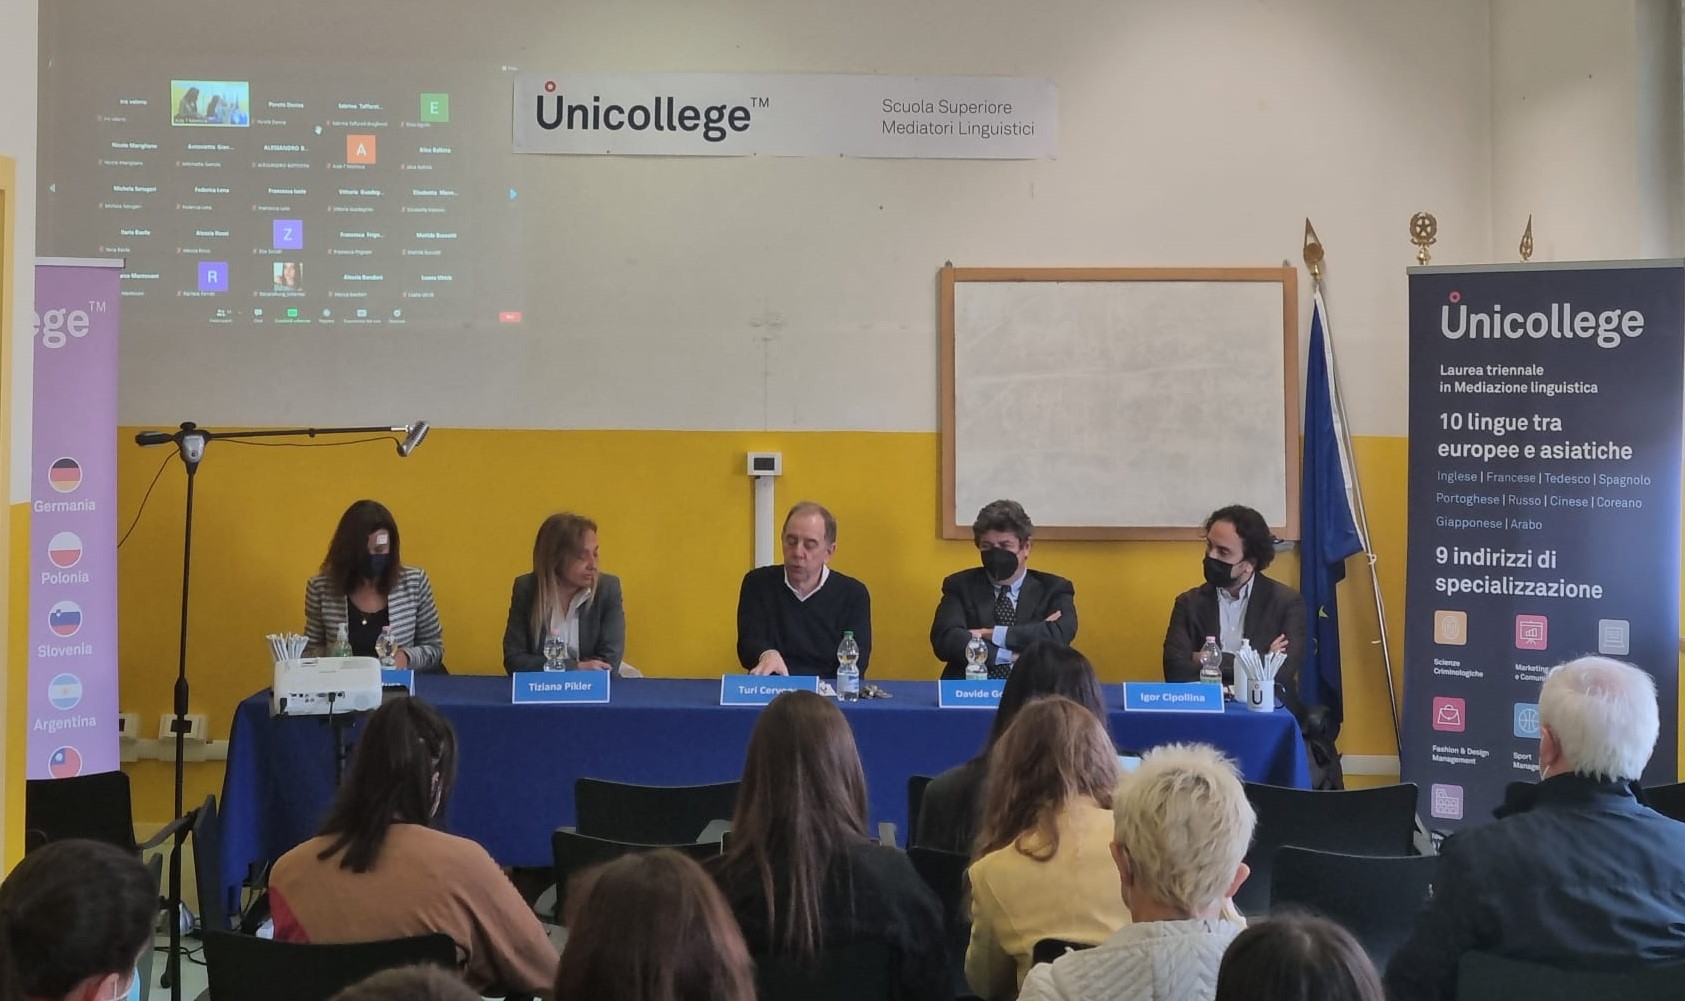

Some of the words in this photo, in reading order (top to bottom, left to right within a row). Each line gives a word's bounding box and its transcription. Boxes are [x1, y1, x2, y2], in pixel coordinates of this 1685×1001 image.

[430, 101, 439, 114] E
[882, 98, 934, 115] Scuola
[938, 99, 1012, 118] Superiore
[882, 121, 954, 136] Mediatori
[958, 121, 1035, 138] Linguistici
[356, 143, 366, 156] A
[284, 228, 292, 242] Z
[208, 270, 218, 284] R
[1440, 365, 1483, 376] Laurea
[1487, 365, 1544, 376] triennale
[1440, 382, 1451, 393] in
[1454, 382, 1527, 393] Mediazione
[1531, 382, 1599, 397] linguistica
[1440, 413, 1462, 430] 10
[1468, 413, 1528, 436] lingue
[1533, 415, 1562, 431] tra
[1438, 444, 1519, 462] europee
[1524, 445, 1536, 459] e
[1540, 441, 1633, 460] asiatiche
[1437, 471, 1477, 484] Inglese
[1486, 472, 1536, 484] Francese
[1545, 474, 1590, 484] Tedesco
[1599, 474, 1651, 487] Spagnolo
[34, 497, 96, 512] Germania
[1436, 493, 1500, 507] Portoghese
[1508, 495, 1541, 506] Russo
[1550, 496, 1588, 507] Cinese
[1597, 497, 1642, 508] Coreano
[1436, 516, 1502, 530] Giapponese
[1510, 519, 1542, 530] Arabo
[1436, 547, 1448, 564] 9
[1453, 548, 1532, 568] indirizzi
[1538, 551, 1557, 569] di
[41, 570, 89, 585] Polonia
[1435, 576, 1603, 599] specializzazione
[38, 642, 93, 656] Slovenia
[1434, 658, 1460, 667] Scienze
[1515, 664, 1549, 673] Marketing
[1434, 668, 1484, 678] Criminologiche
[528, 681, 562, 691] Tiziana
[564, 681, 591, 691] Pikler
[739, 686, 757, 694] Turi
[1140, 692, 1161, 704] Igor
[1162, 692, 1206, 704] Cipollina
[34, 714, 96, 730] Argentina
[1432, 746, 1459, 754] Fashion
[1467, 748, 1489, 757] Design
[1513, 752, 1532, 762] Sport
[1432, 754, 1476, 765] Management
